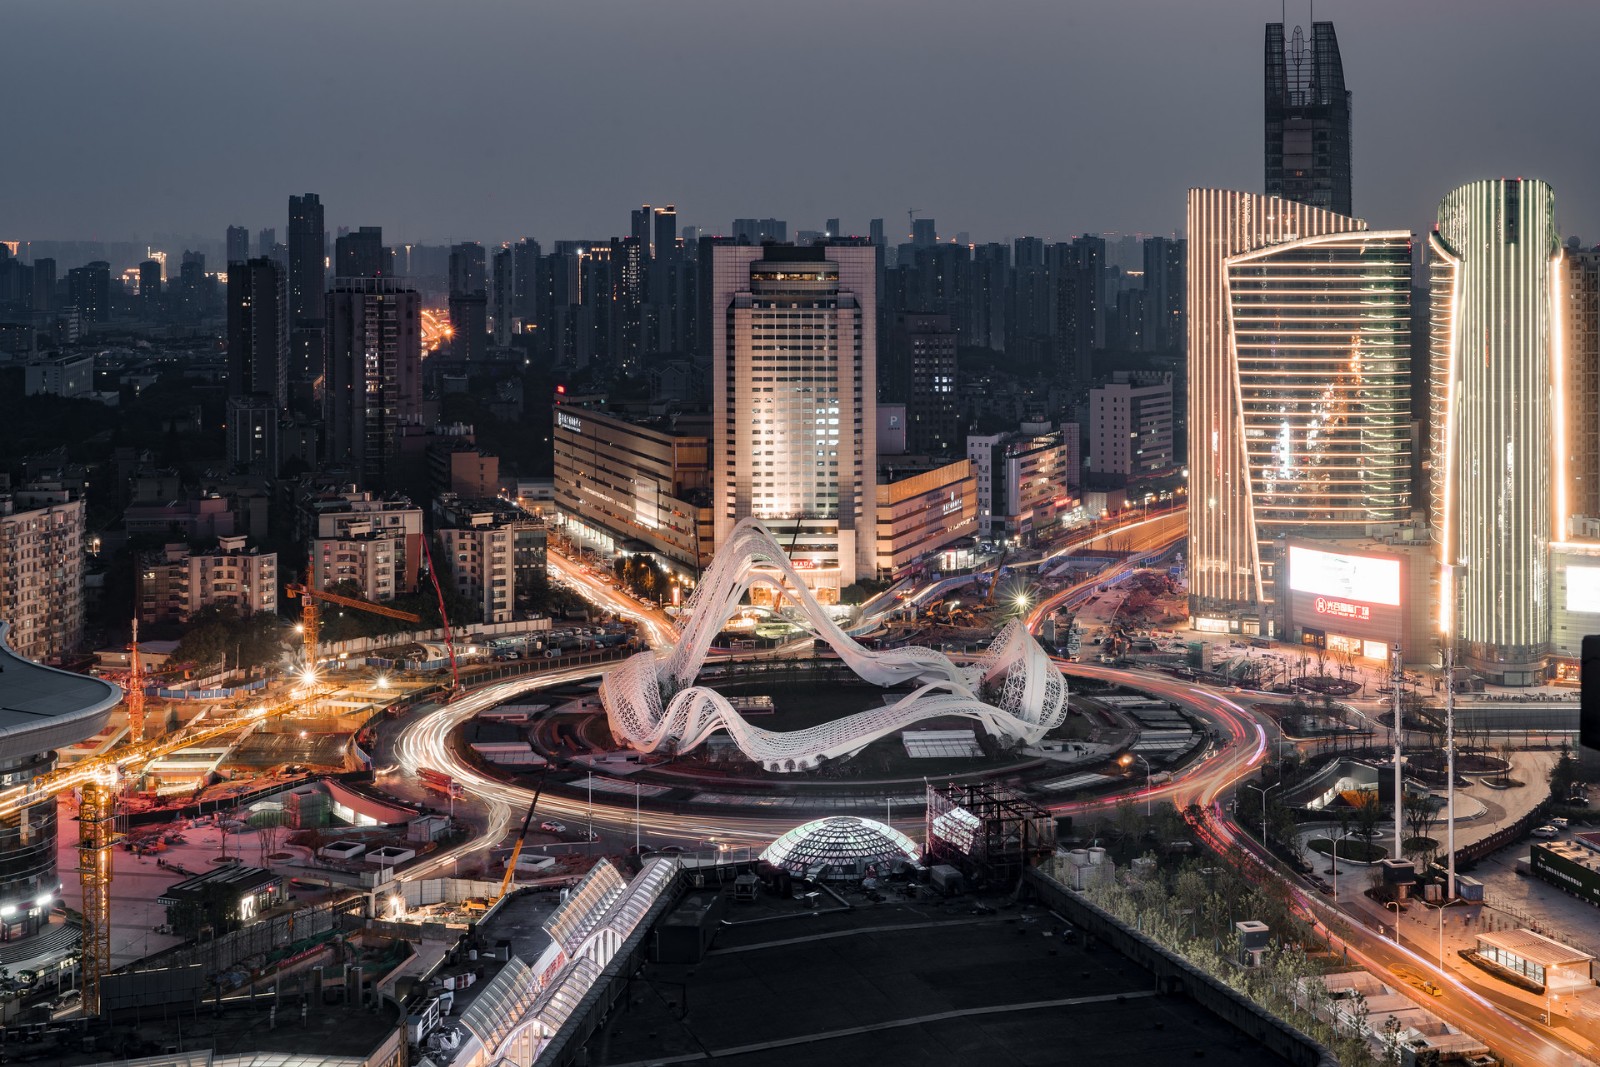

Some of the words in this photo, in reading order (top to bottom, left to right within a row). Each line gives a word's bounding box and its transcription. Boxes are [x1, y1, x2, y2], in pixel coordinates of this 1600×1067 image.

[890, 415, 898, 426] P
[1327, 601, 1370, 616] 光谷国际广场
